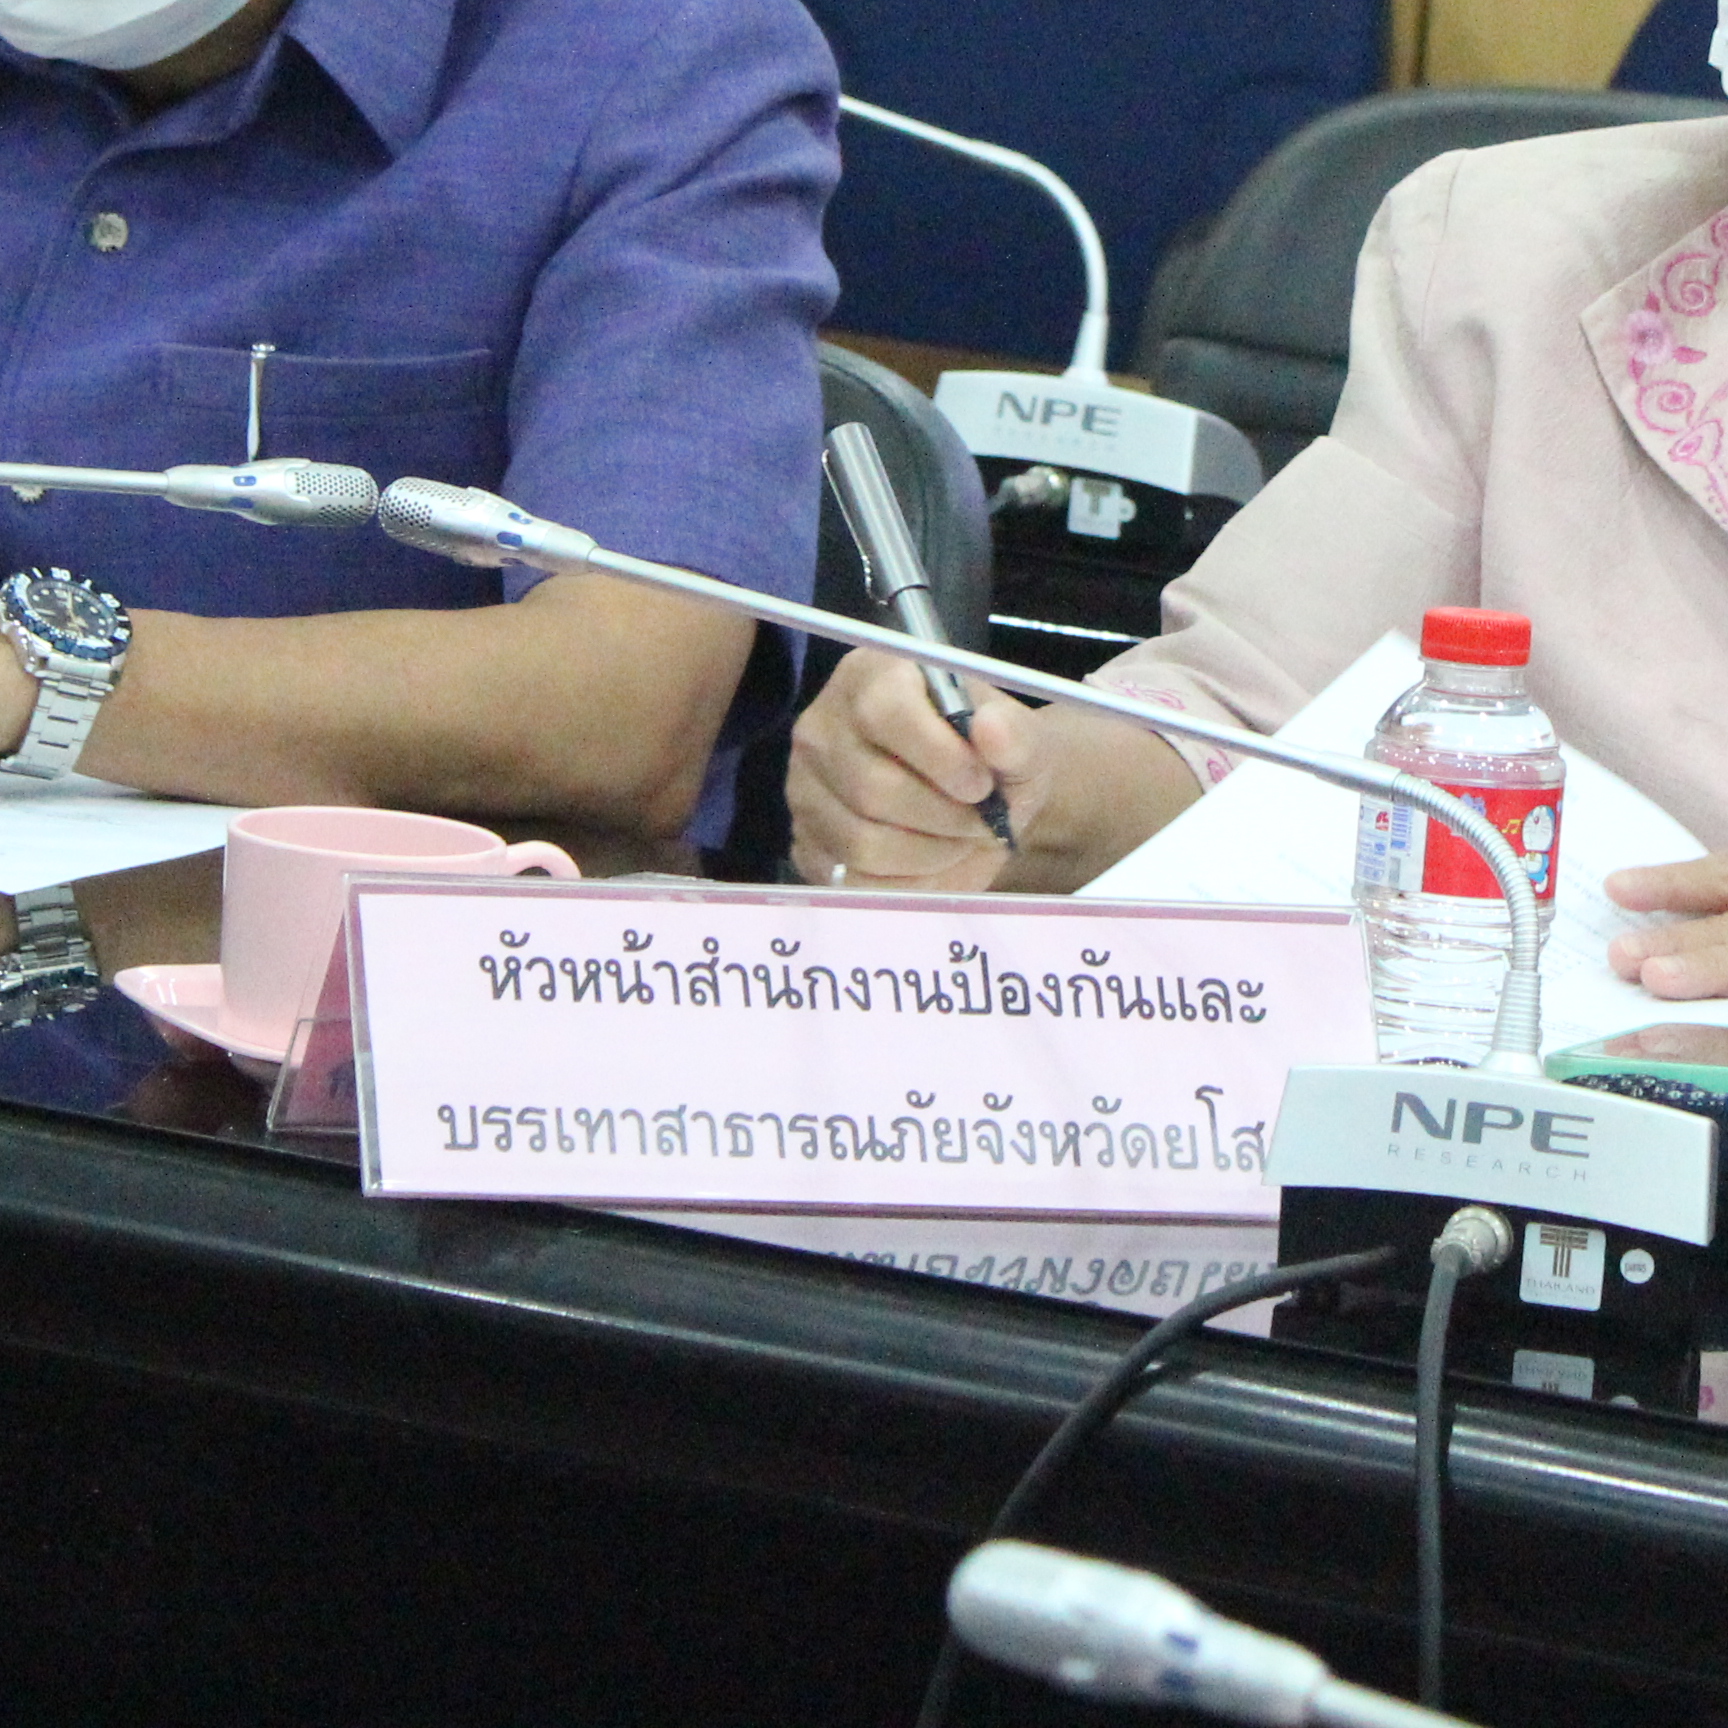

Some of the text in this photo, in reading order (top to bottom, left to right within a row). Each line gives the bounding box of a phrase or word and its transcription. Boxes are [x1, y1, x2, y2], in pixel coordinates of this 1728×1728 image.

[997, 391, 1122, 438] NPE
[479, 931, 1268, 1025] หัวหน้าสำนักงานป้องกันและ
[1390, 1091, 1594, 1159] NPE
[1387, 1143, 1586, 1182] RESEARCH
